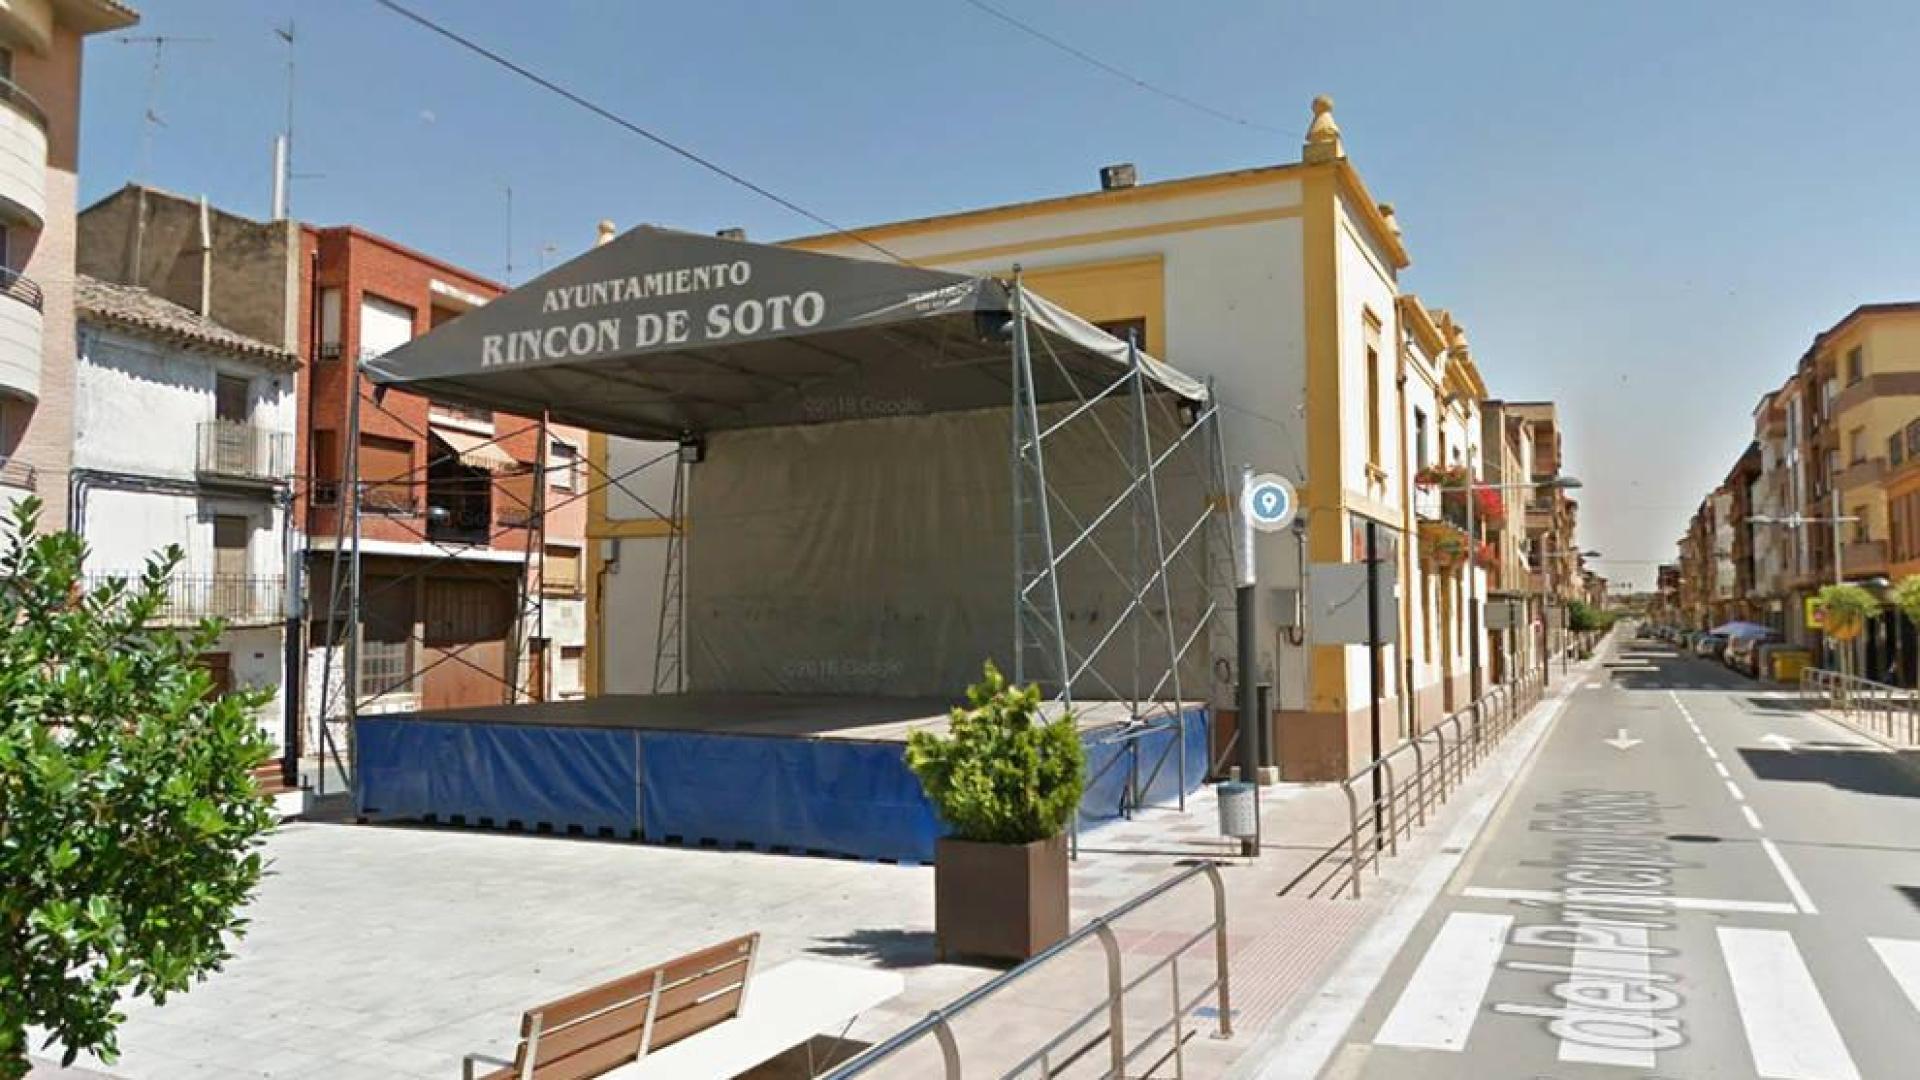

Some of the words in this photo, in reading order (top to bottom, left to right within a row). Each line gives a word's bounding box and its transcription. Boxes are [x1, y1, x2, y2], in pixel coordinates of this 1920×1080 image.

[542, 260, 751, 313] AYUNTAMIENTO
[480, 317, 622, 367] RINCON
[635, 309, 691, 348] DE
[705, 291, 825, 339] SOTO
